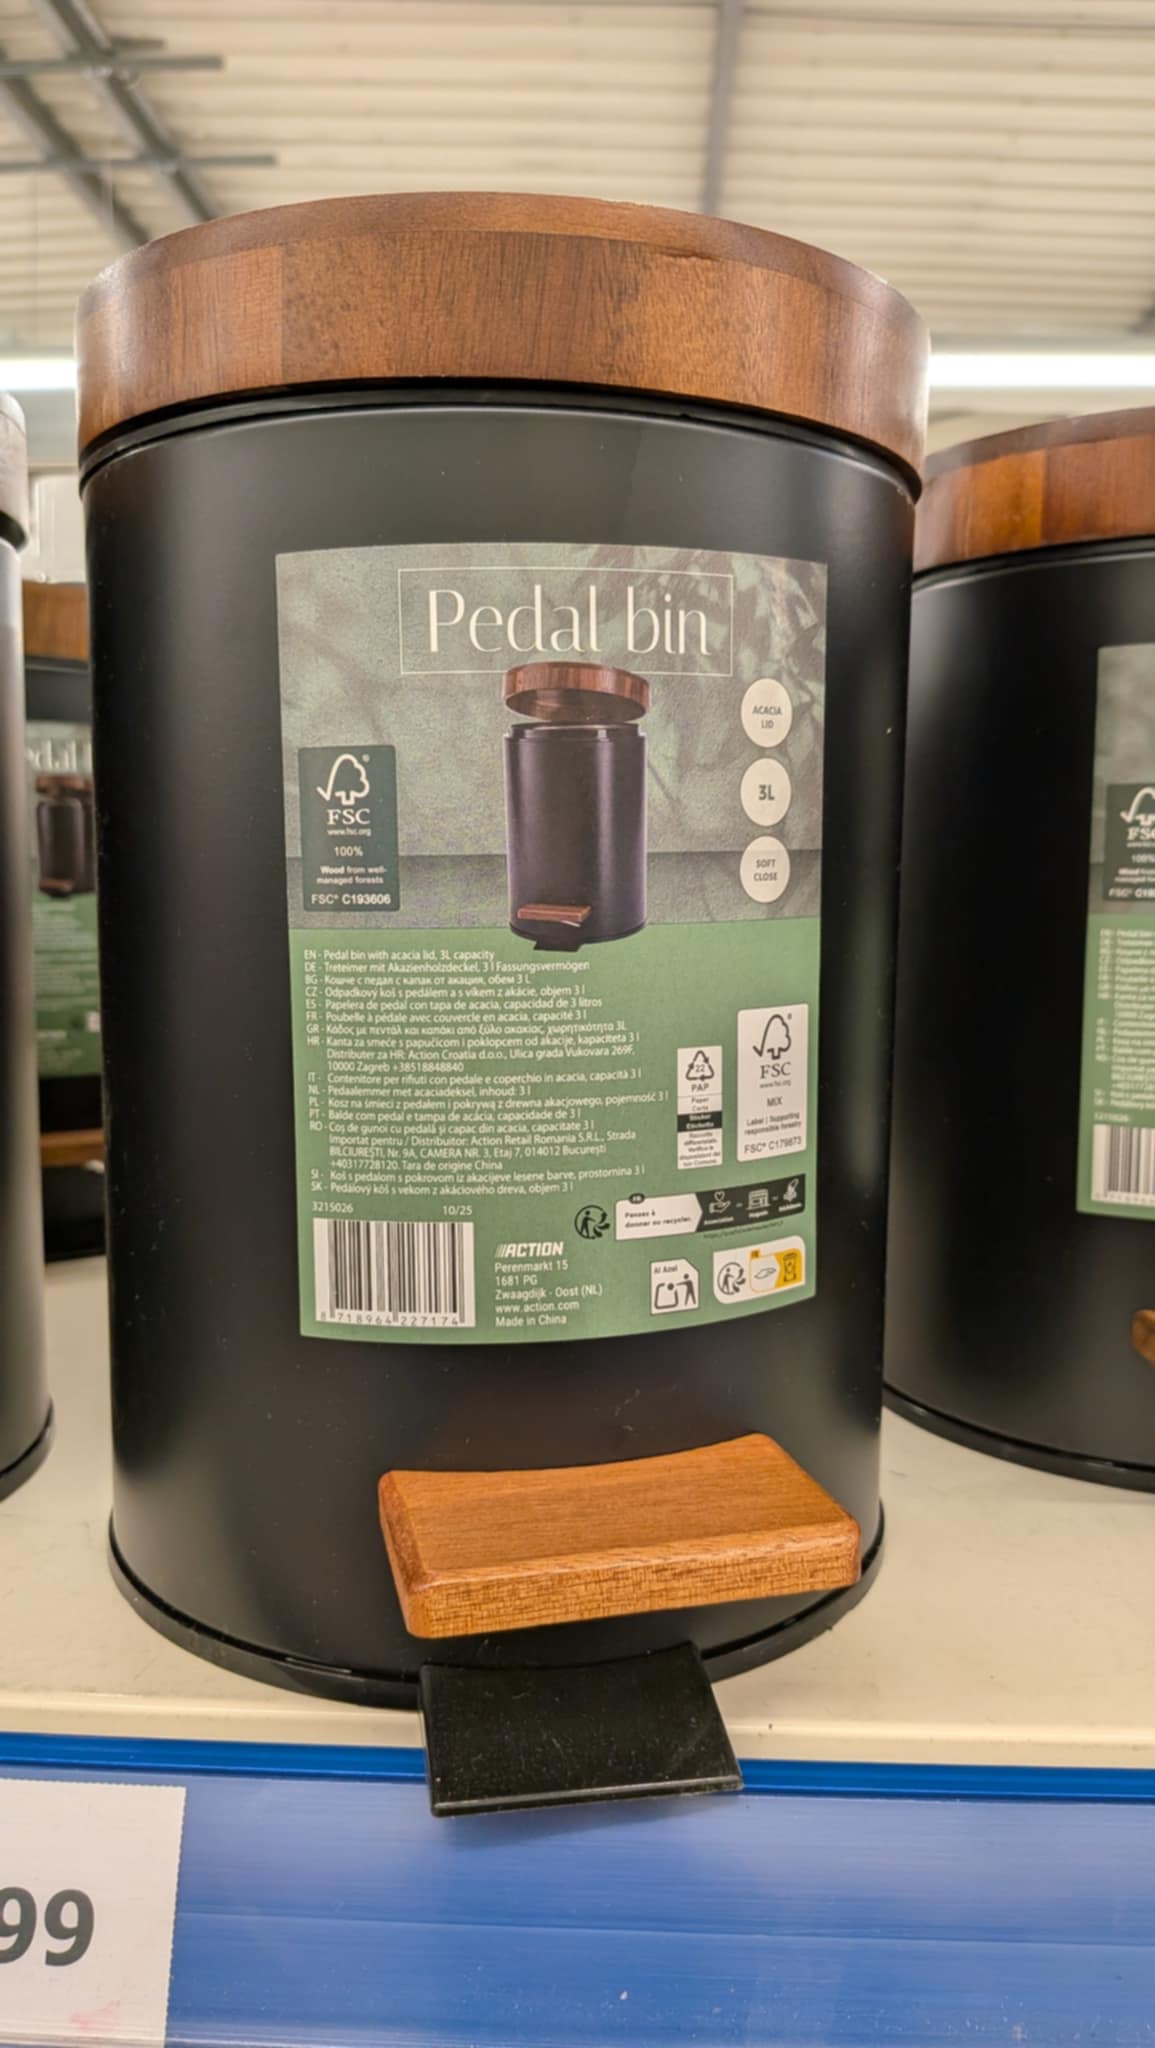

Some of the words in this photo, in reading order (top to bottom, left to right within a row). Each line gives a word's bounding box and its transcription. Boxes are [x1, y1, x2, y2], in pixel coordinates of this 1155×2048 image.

[428, 584, 602, 652] Pedal
[626, 585, 712, 656] bin
[752, 705, 783, 716] ACACIA
[760, 719, 775, 729] LID
[758, 784, 775, 801] 3L
[326, 807, 372, 825] FSC
[326, 827, 372, 837] www.fsc.org
[334, 845, 364, 857] 100%
[755, 858, 777, 869] SOFT
[320, 865, 345, 875] Wood
[346, 865, 366, 874] from
[367, 865, 388, 874] well-
[316, 876, 353, 886] managed
[354, 875, 384, 884] forests
[752, 872, 778, 882] CLOSE
[341, 893, 392, 905] C193606
[694, 1063, 706, 1073] 22
[759, 1061, 792, 1079] FSC
[690, 1082, 710, 1093] PAP
[690, 1096, 710, 1106] Paper
[766, 1095, 784, 1107] MIX
[312, 1201, 354, 1213] 3215026
[442, 1204, 473, 1216] 10/25
[504, 1241, 564, 1257] ACTION
[494, 1261, 553, 1272] Perenmarkt
[556, 1259, 569, 1271] 15
[496, 1275, 519, 1287] 1681
[523, 1274, 538, 1286] PG
[495, 1287, 547, 1301] Zwaagdijk
[554, 1284, 579, 1298] Oost
[581, 1282, 604, 1298] (NL)
[495, 1300, 580, 1313] www.action.com
[495, 1315, 525, 1328] Made
[526, 1313, 537, 1326] in
[538, 1312, 568, 1326] China
[0, 1886, 95, 1967] 99
